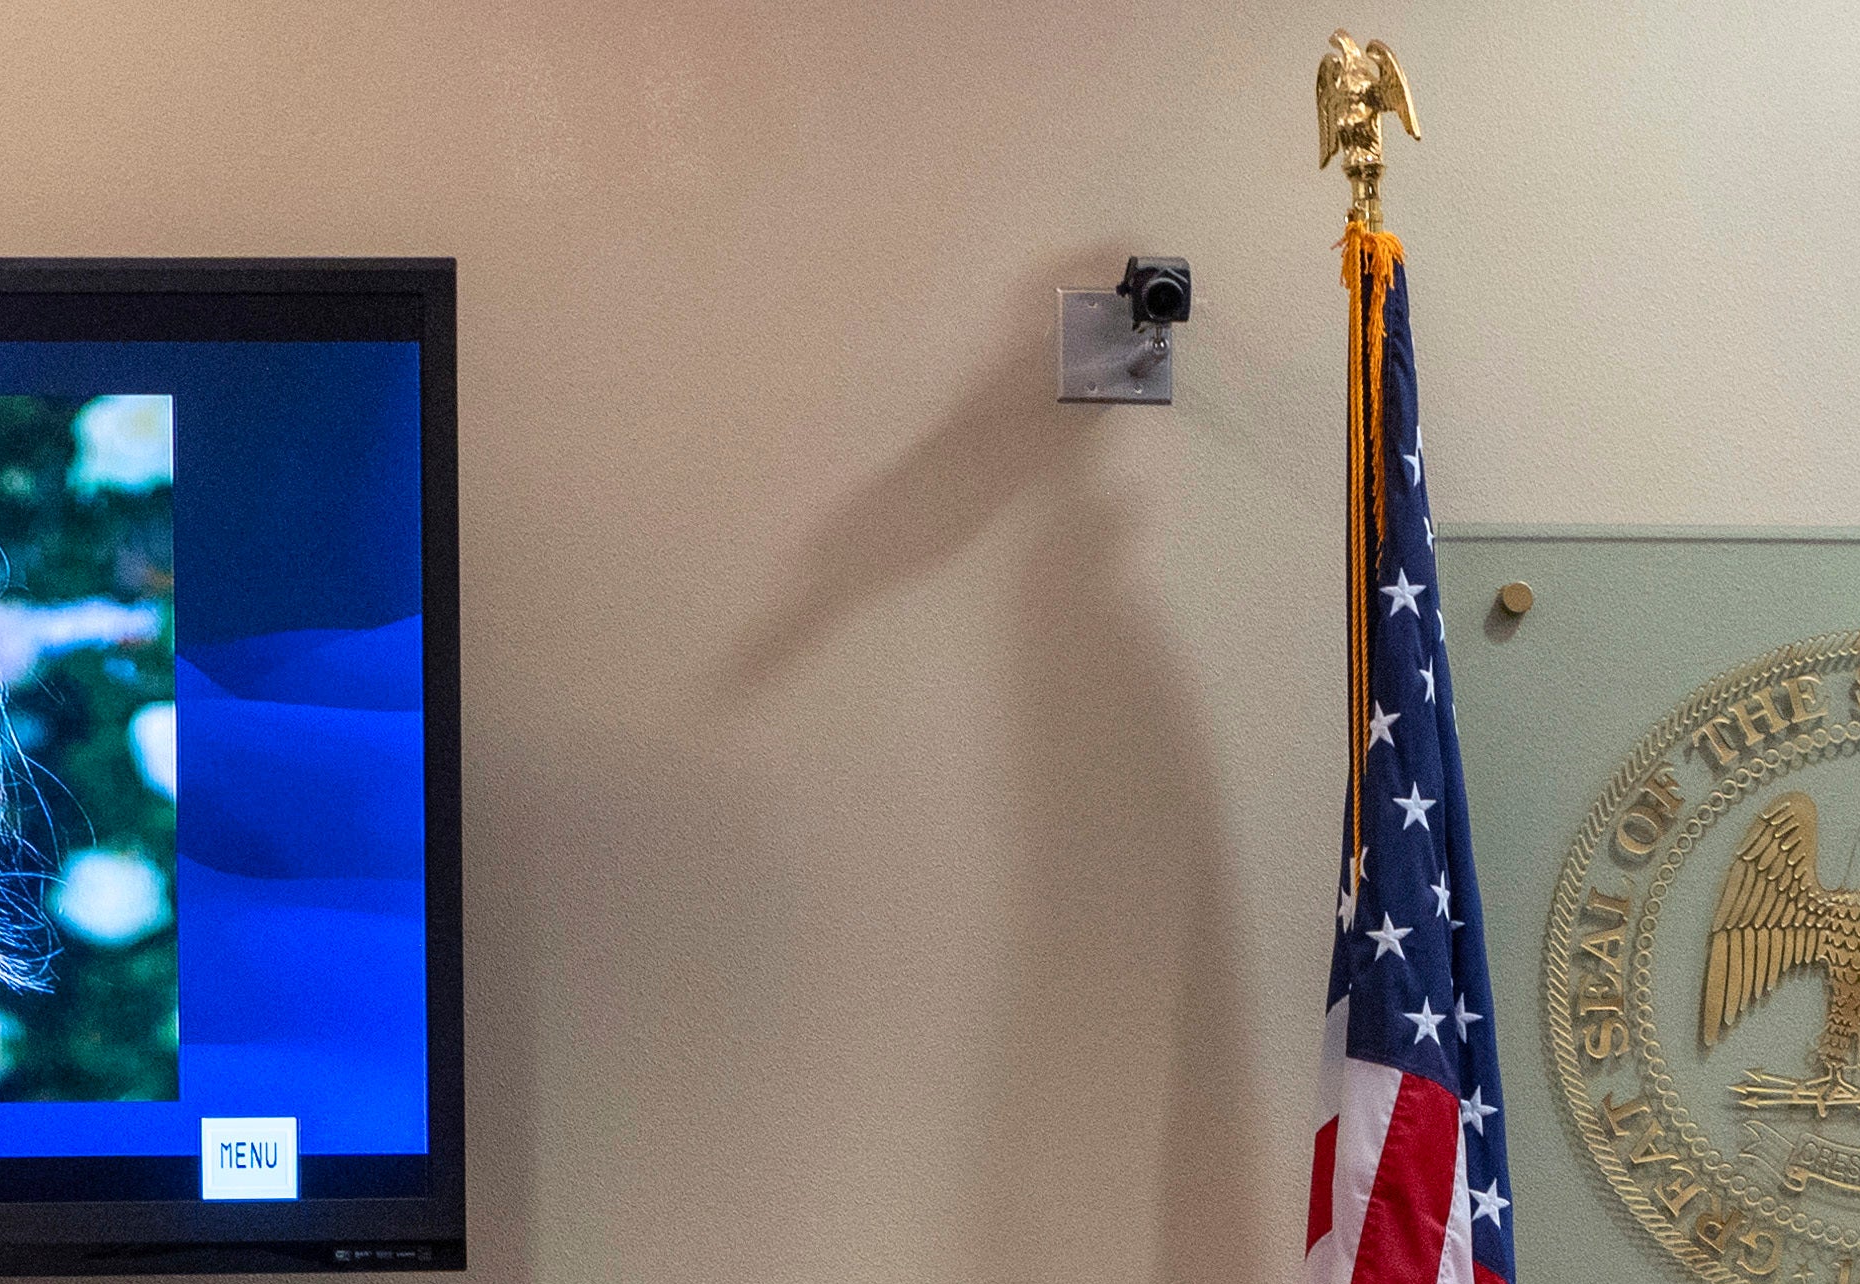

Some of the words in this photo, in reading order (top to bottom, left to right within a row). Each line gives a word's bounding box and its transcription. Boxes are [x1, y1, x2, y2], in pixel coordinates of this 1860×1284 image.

[1692, 674, 1828, 766] THE
[1616, 763, 1685, 855] OF
[1578, 879, 1632, 1060] SEAL
[220, 1142, 277, 1169] MENU
[1602, 1091, 1783, 1276] GREAT
